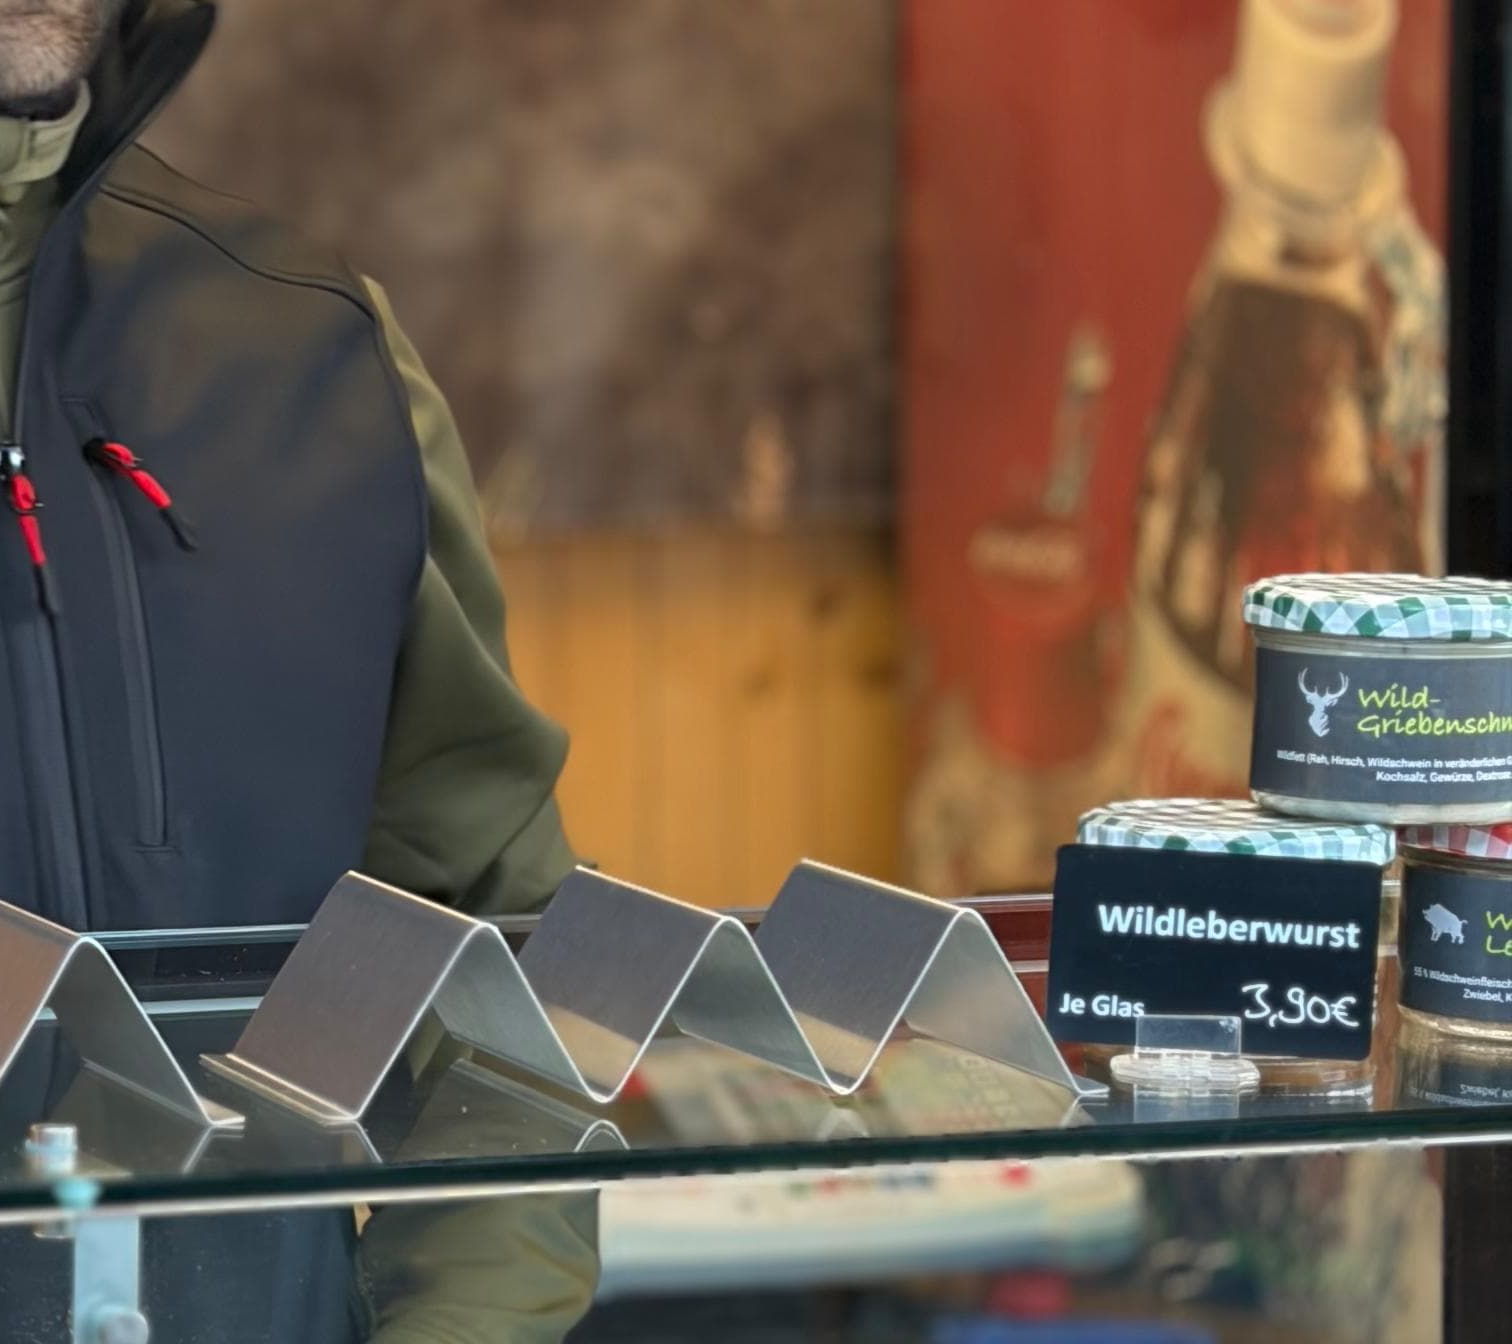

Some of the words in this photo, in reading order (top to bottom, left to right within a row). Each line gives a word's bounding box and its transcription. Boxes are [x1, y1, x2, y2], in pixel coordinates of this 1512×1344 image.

[1357, 682, 1441, 709] Wild-
[1331, 755, 1366, 768] Hirsch,
[1367, 757, 1431, 769] Wildschwein
[1433, 758, 1443, 768] in
[1375, 771, 1428, 784] Kochsalz,
[1429, 771, 1475, 783] Gewürze,
[1098, 904, 1361, 949] Wildleberwurst
[1059, 992, 1085, 1015] Je
[1091, 994, 1146, 1018] Glas
[1241, 982, 1360, 1028] 3,90€
